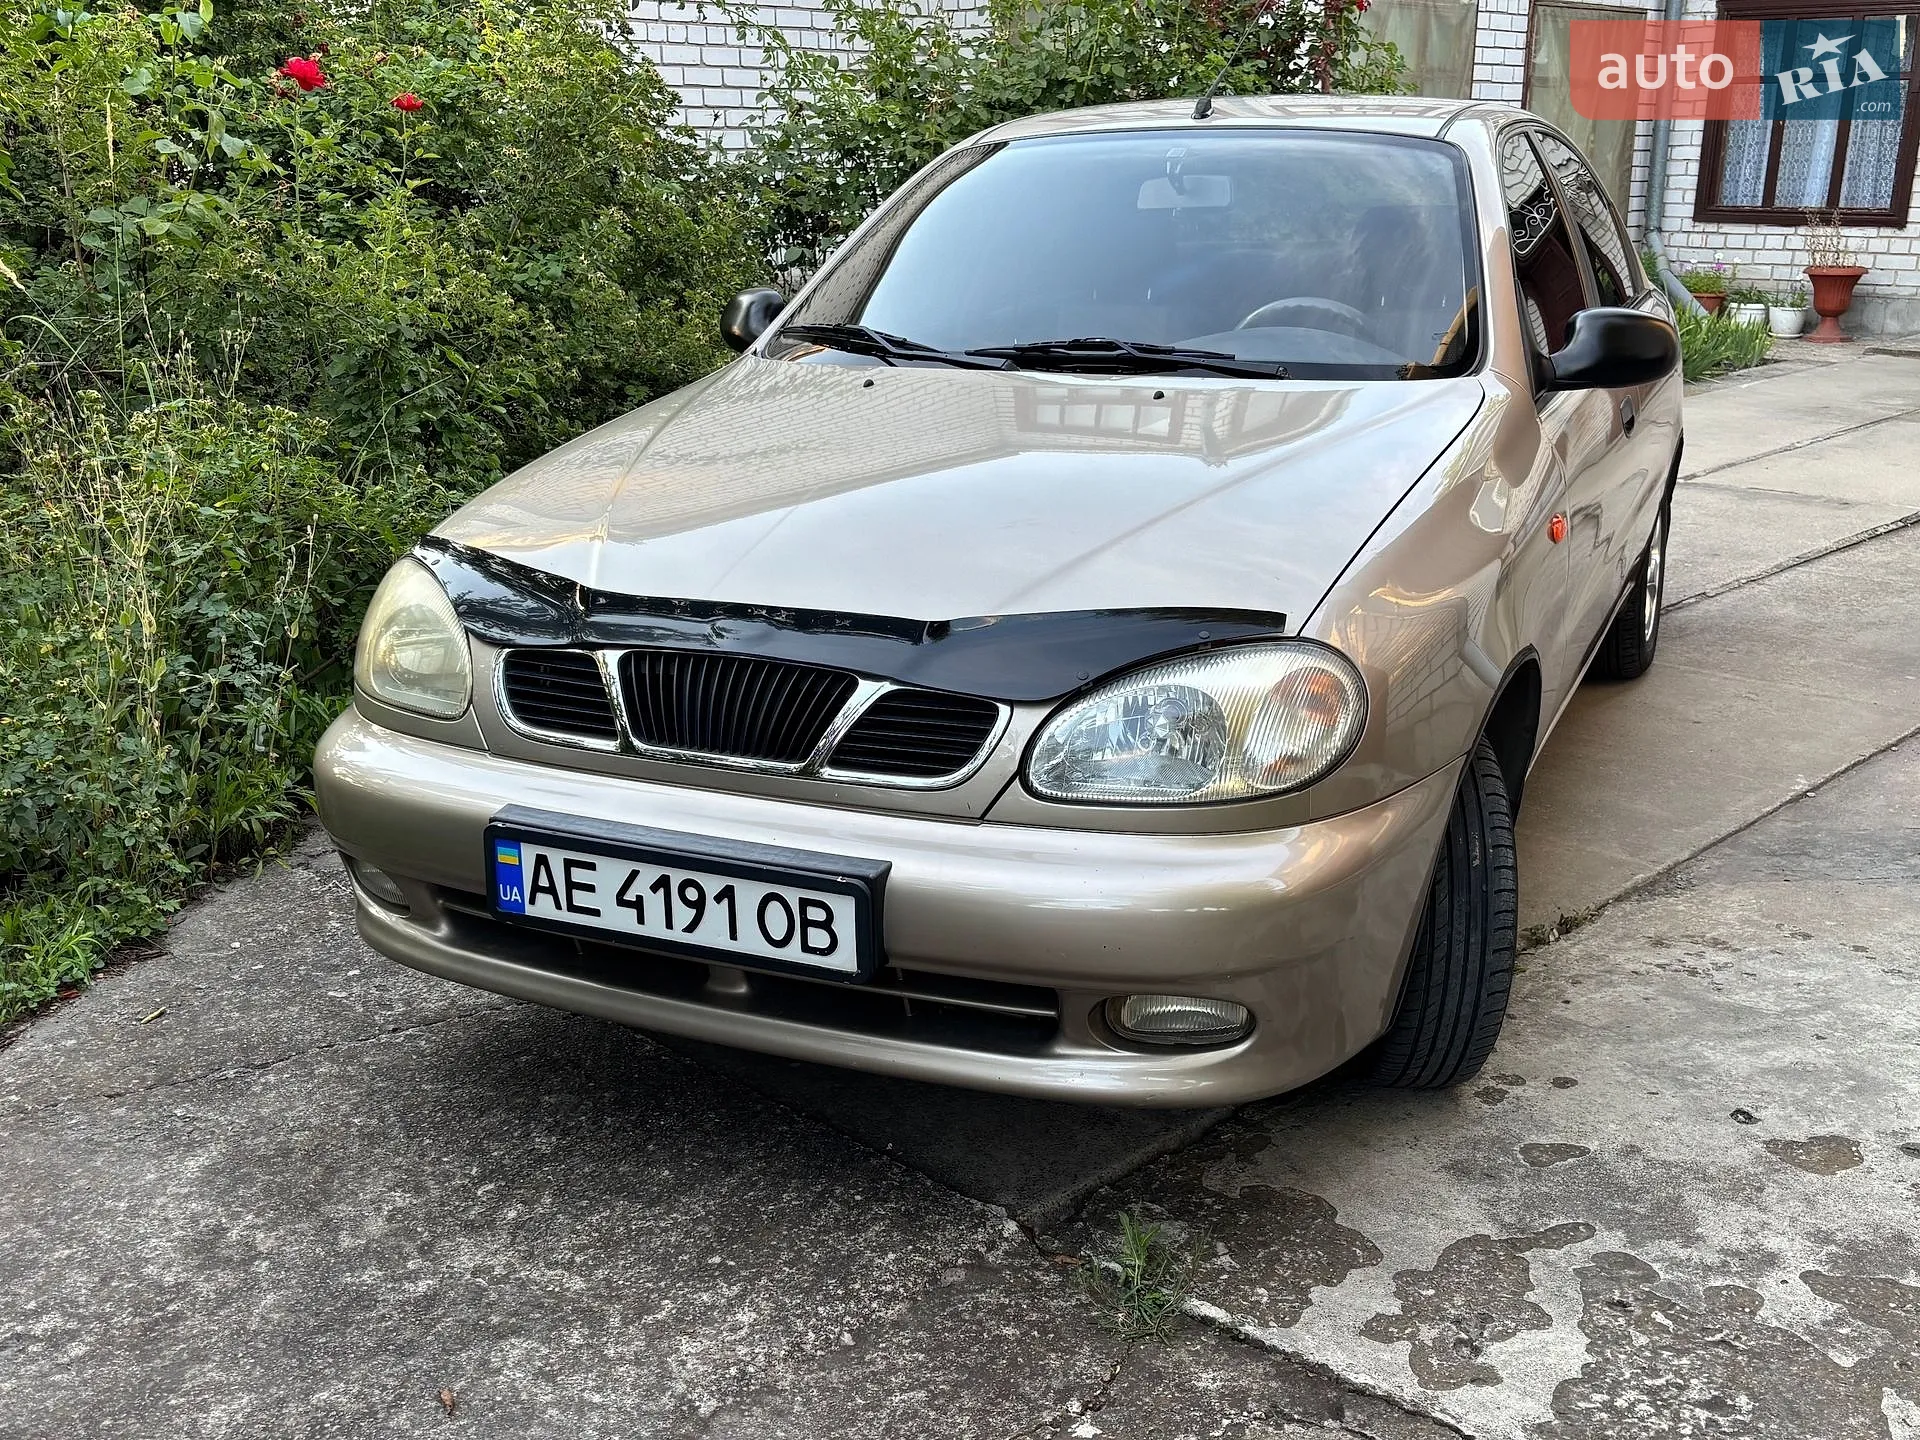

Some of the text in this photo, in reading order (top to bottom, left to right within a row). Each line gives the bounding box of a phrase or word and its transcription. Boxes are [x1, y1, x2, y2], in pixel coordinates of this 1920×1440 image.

[499, 883, 522, 903] UA
[528, 853, 839, 956] AE 4191 OB
